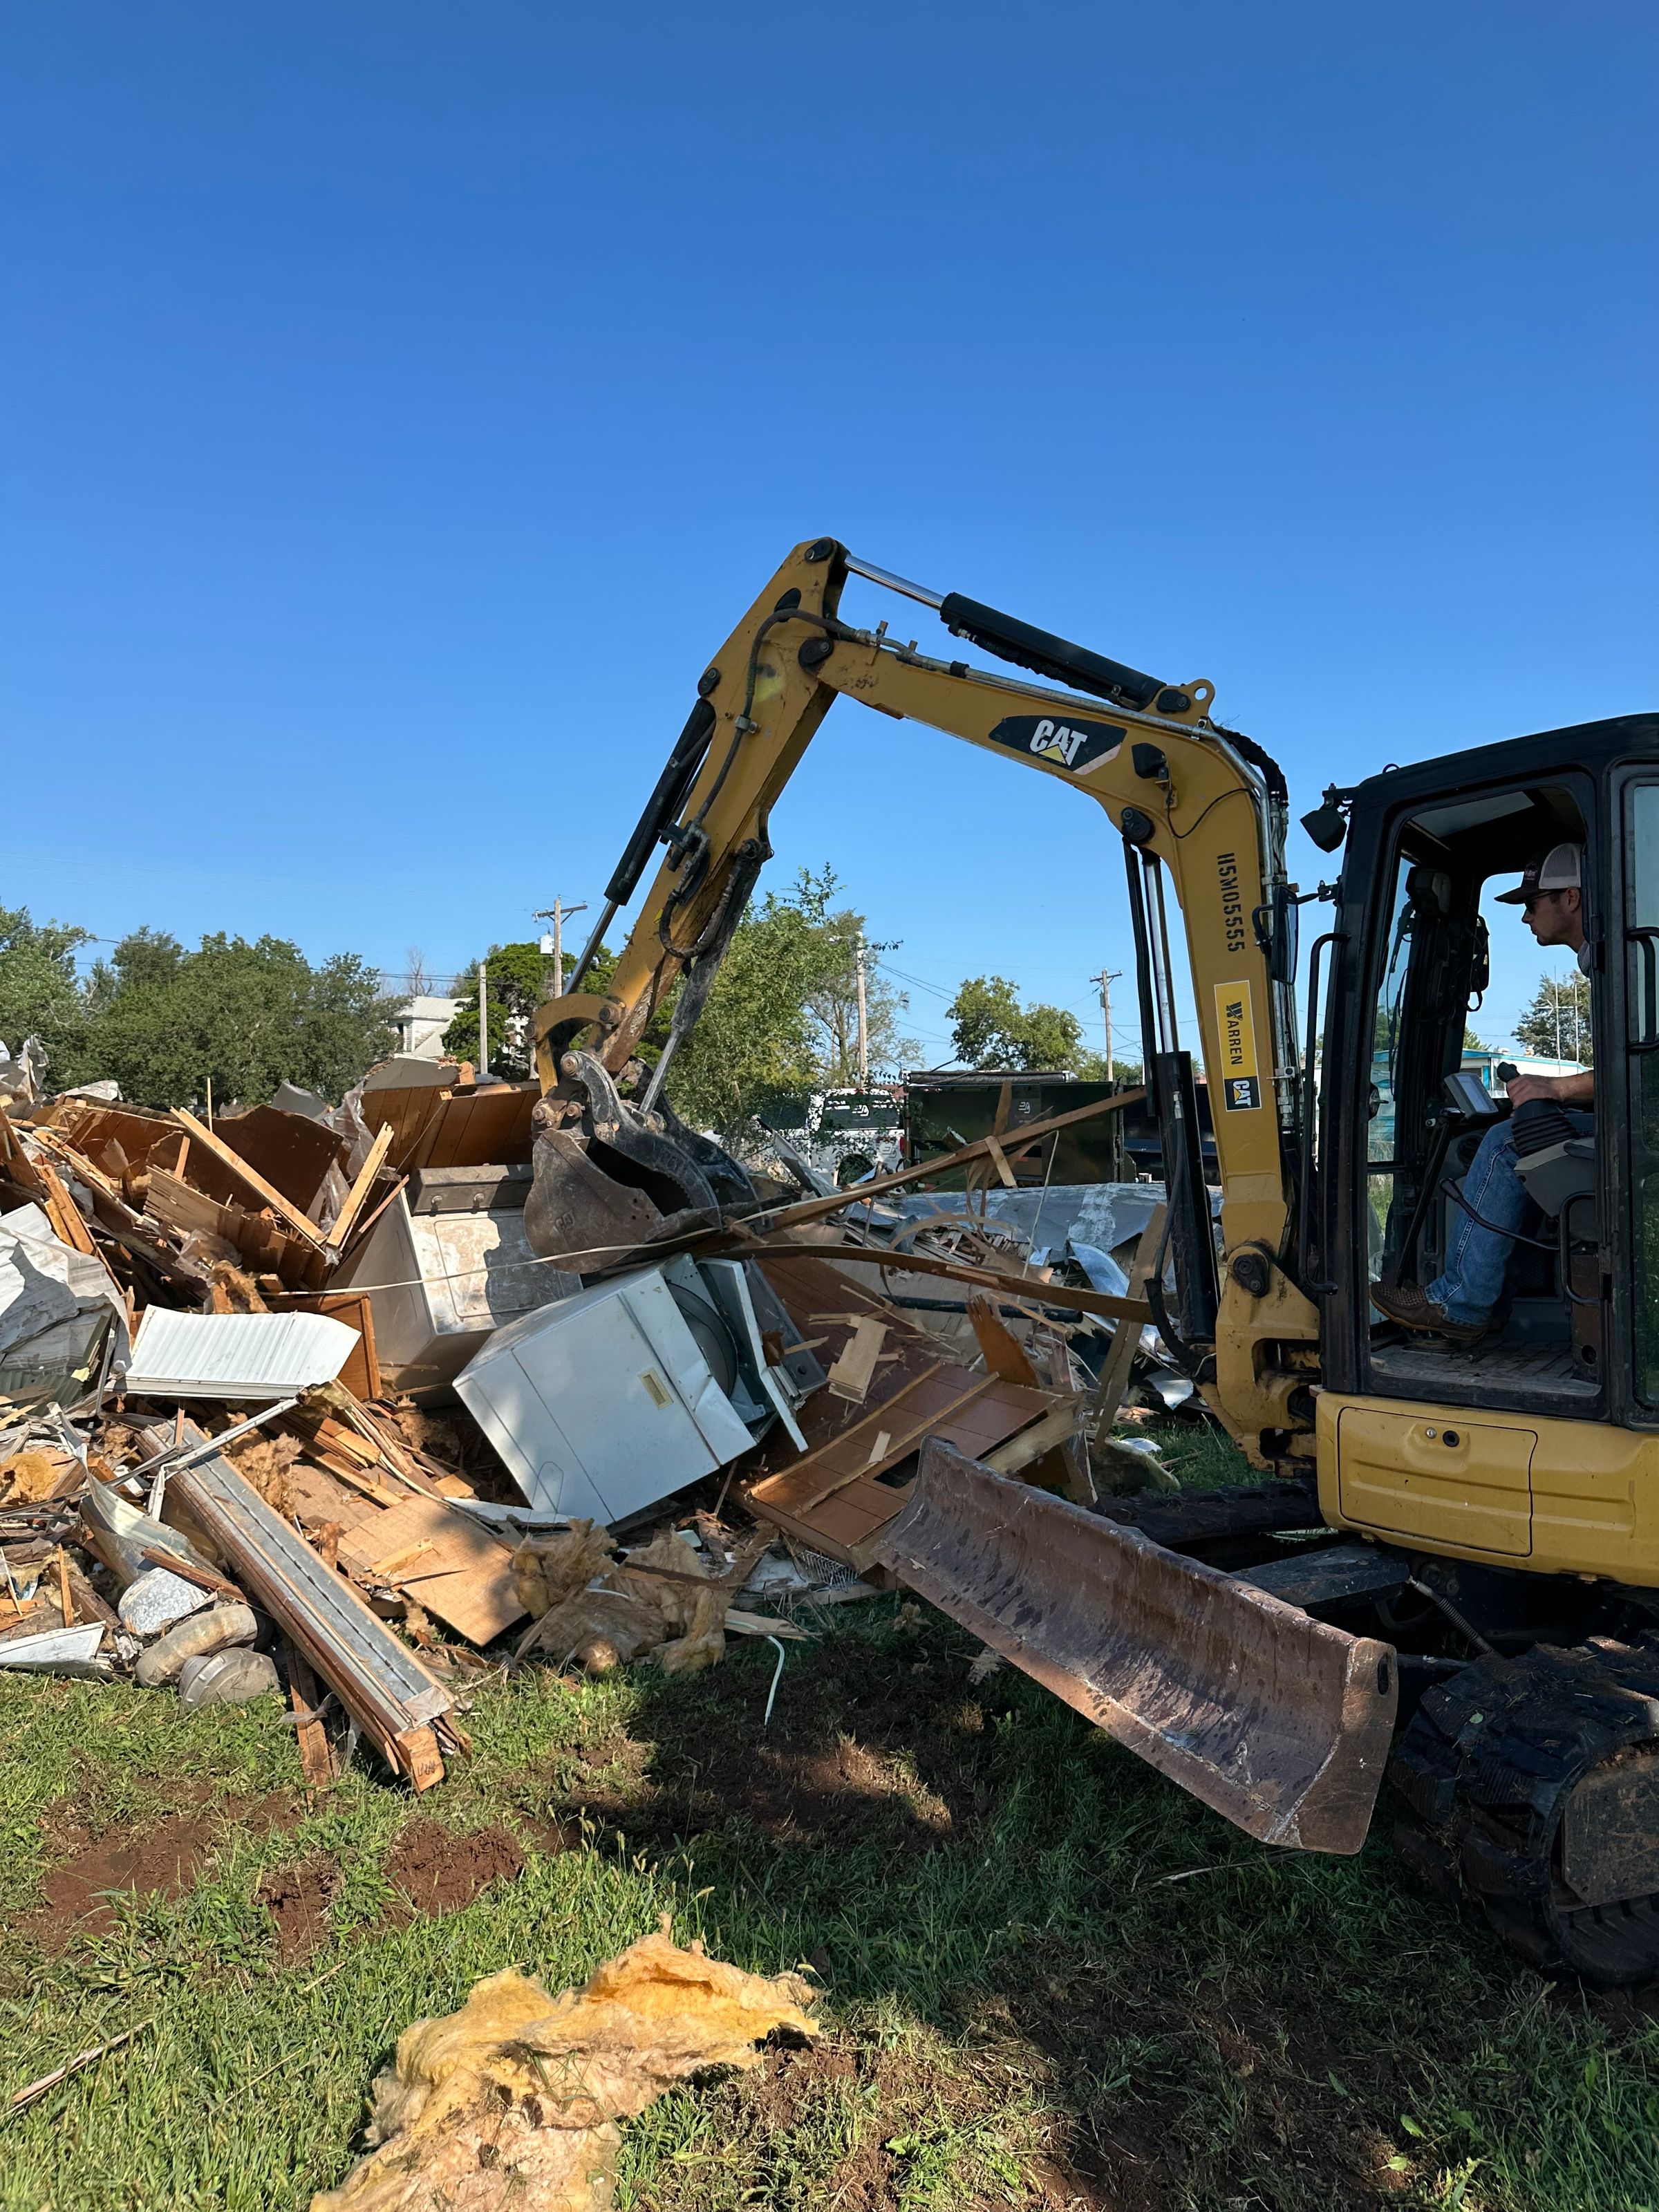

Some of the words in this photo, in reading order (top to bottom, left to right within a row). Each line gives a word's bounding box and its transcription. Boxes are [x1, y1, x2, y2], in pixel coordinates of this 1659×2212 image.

[1029, 719, 1088, 766] CAT
[1226, 1000, 1244, 1066] WARREN
[1232, 1079, 1252, 1107] CAT
